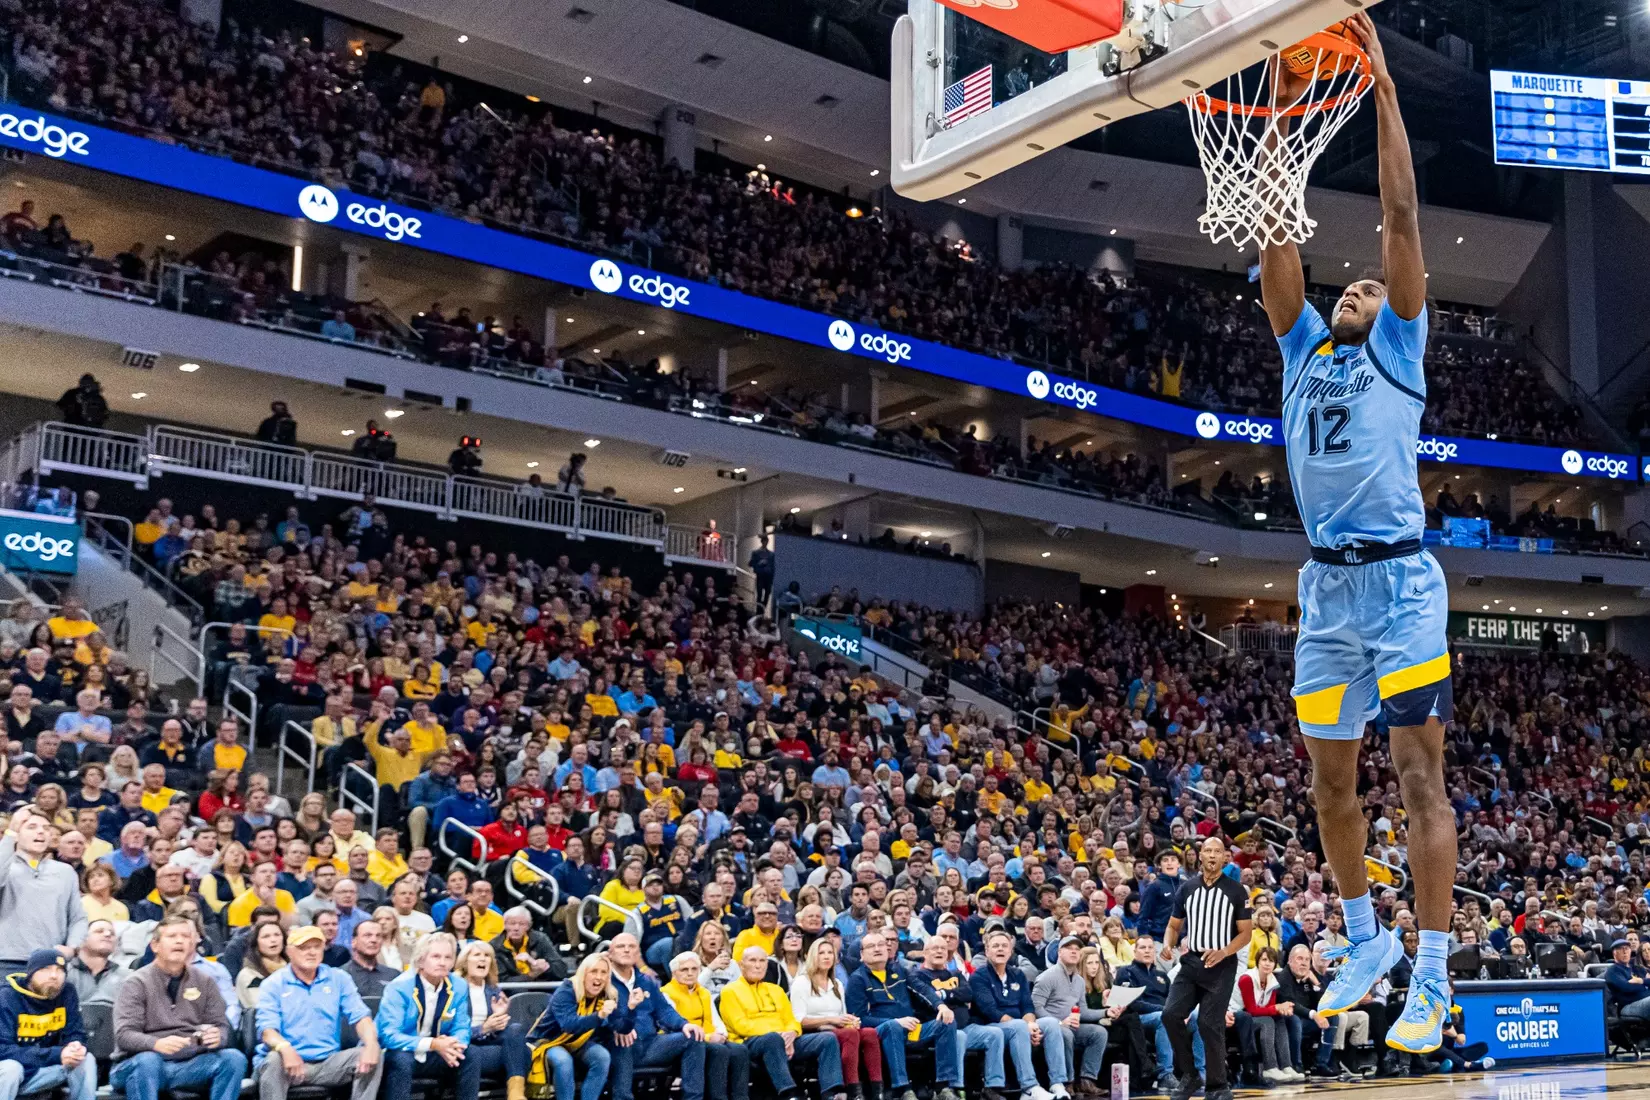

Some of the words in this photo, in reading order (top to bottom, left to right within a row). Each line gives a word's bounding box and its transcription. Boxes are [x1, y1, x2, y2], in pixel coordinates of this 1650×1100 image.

[1512, 75, 1584, 93] MARQUETTE
[0, 113, 90, 157] edge
[346, 202, 422, 241] edge
[628, 274, 690, 308] edge
[122, 350, 158, 369] 106
[860, 333, 912, 363] edge
[1053, 382, 1097, 410] edge
[1224, 418, 1273, 443] edge
[1307, 405, 1352, 456] 12
[662, 453, 689, 468] 106
[1586, 455, 1629, 478] edge
[4, 531, 74, 561] edge
[1467, 617, 1508, 638] FEAR
[1511, 620, 1541, 641] THE
[1496, 1006, 1508, 1015] ONE
[1508, 1006, 1521, 1015] CALL
[1549, 1005, 1559, 1013] ALL
[1496, 1019, 1559, 1042] GRUBER
